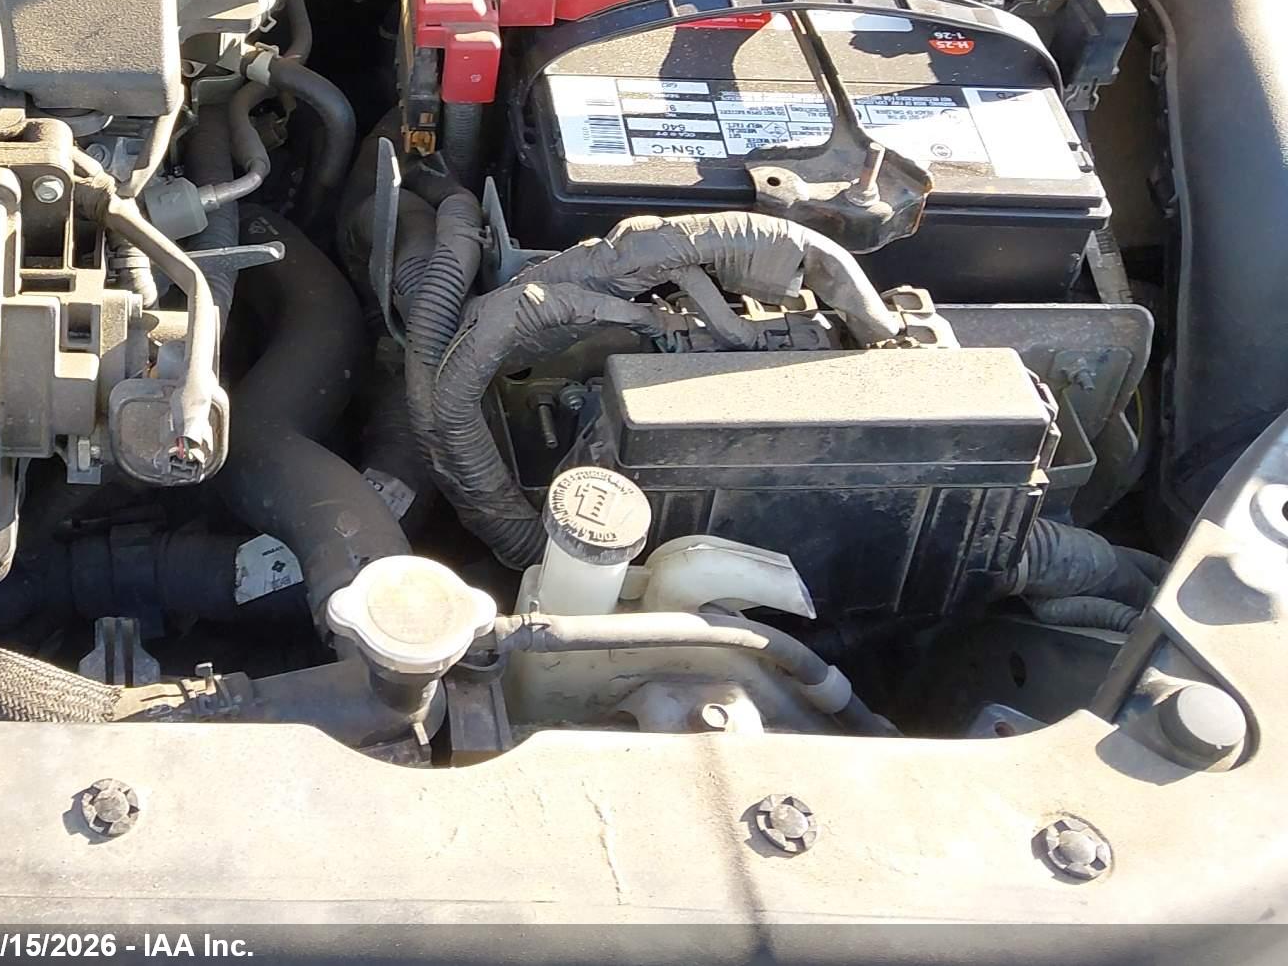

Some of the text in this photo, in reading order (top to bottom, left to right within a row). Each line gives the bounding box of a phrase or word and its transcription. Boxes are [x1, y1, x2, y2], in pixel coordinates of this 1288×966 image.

[935, 40, 970, 49] H-25
[661, 123, 686, 131] 640
[651, 144, 705, 155] 35N-C
